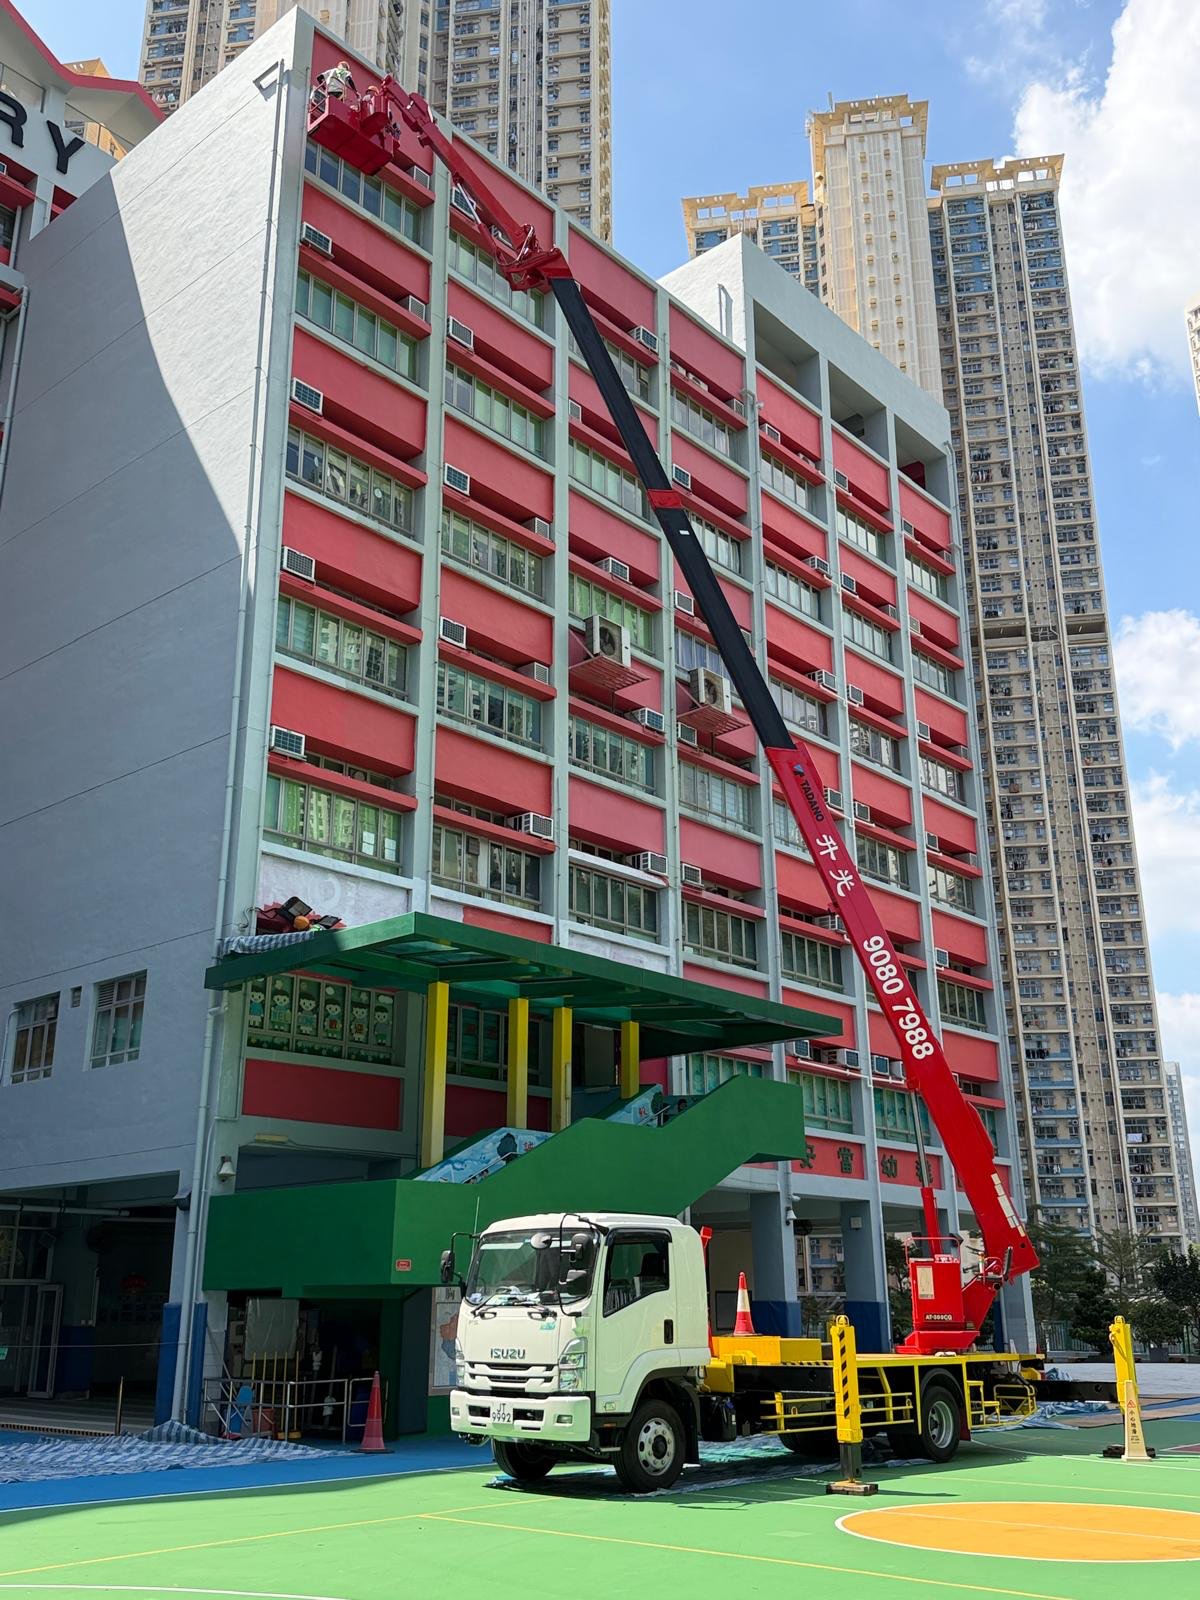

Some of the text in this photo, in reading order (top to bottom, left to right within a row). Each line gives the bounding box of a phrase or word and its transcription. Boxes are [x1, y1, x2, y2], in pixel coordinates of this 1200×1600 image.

[800, 778, 825, 822] TADANO
[815, 834, 855, 897] 升光
[863, 935, 934, 1060] 9080 7988
[490, 1347, 526, 1360] ISUZU
[491, 1411, 512, 1423] 9992
[497, 1402, 506, 1413] JT
